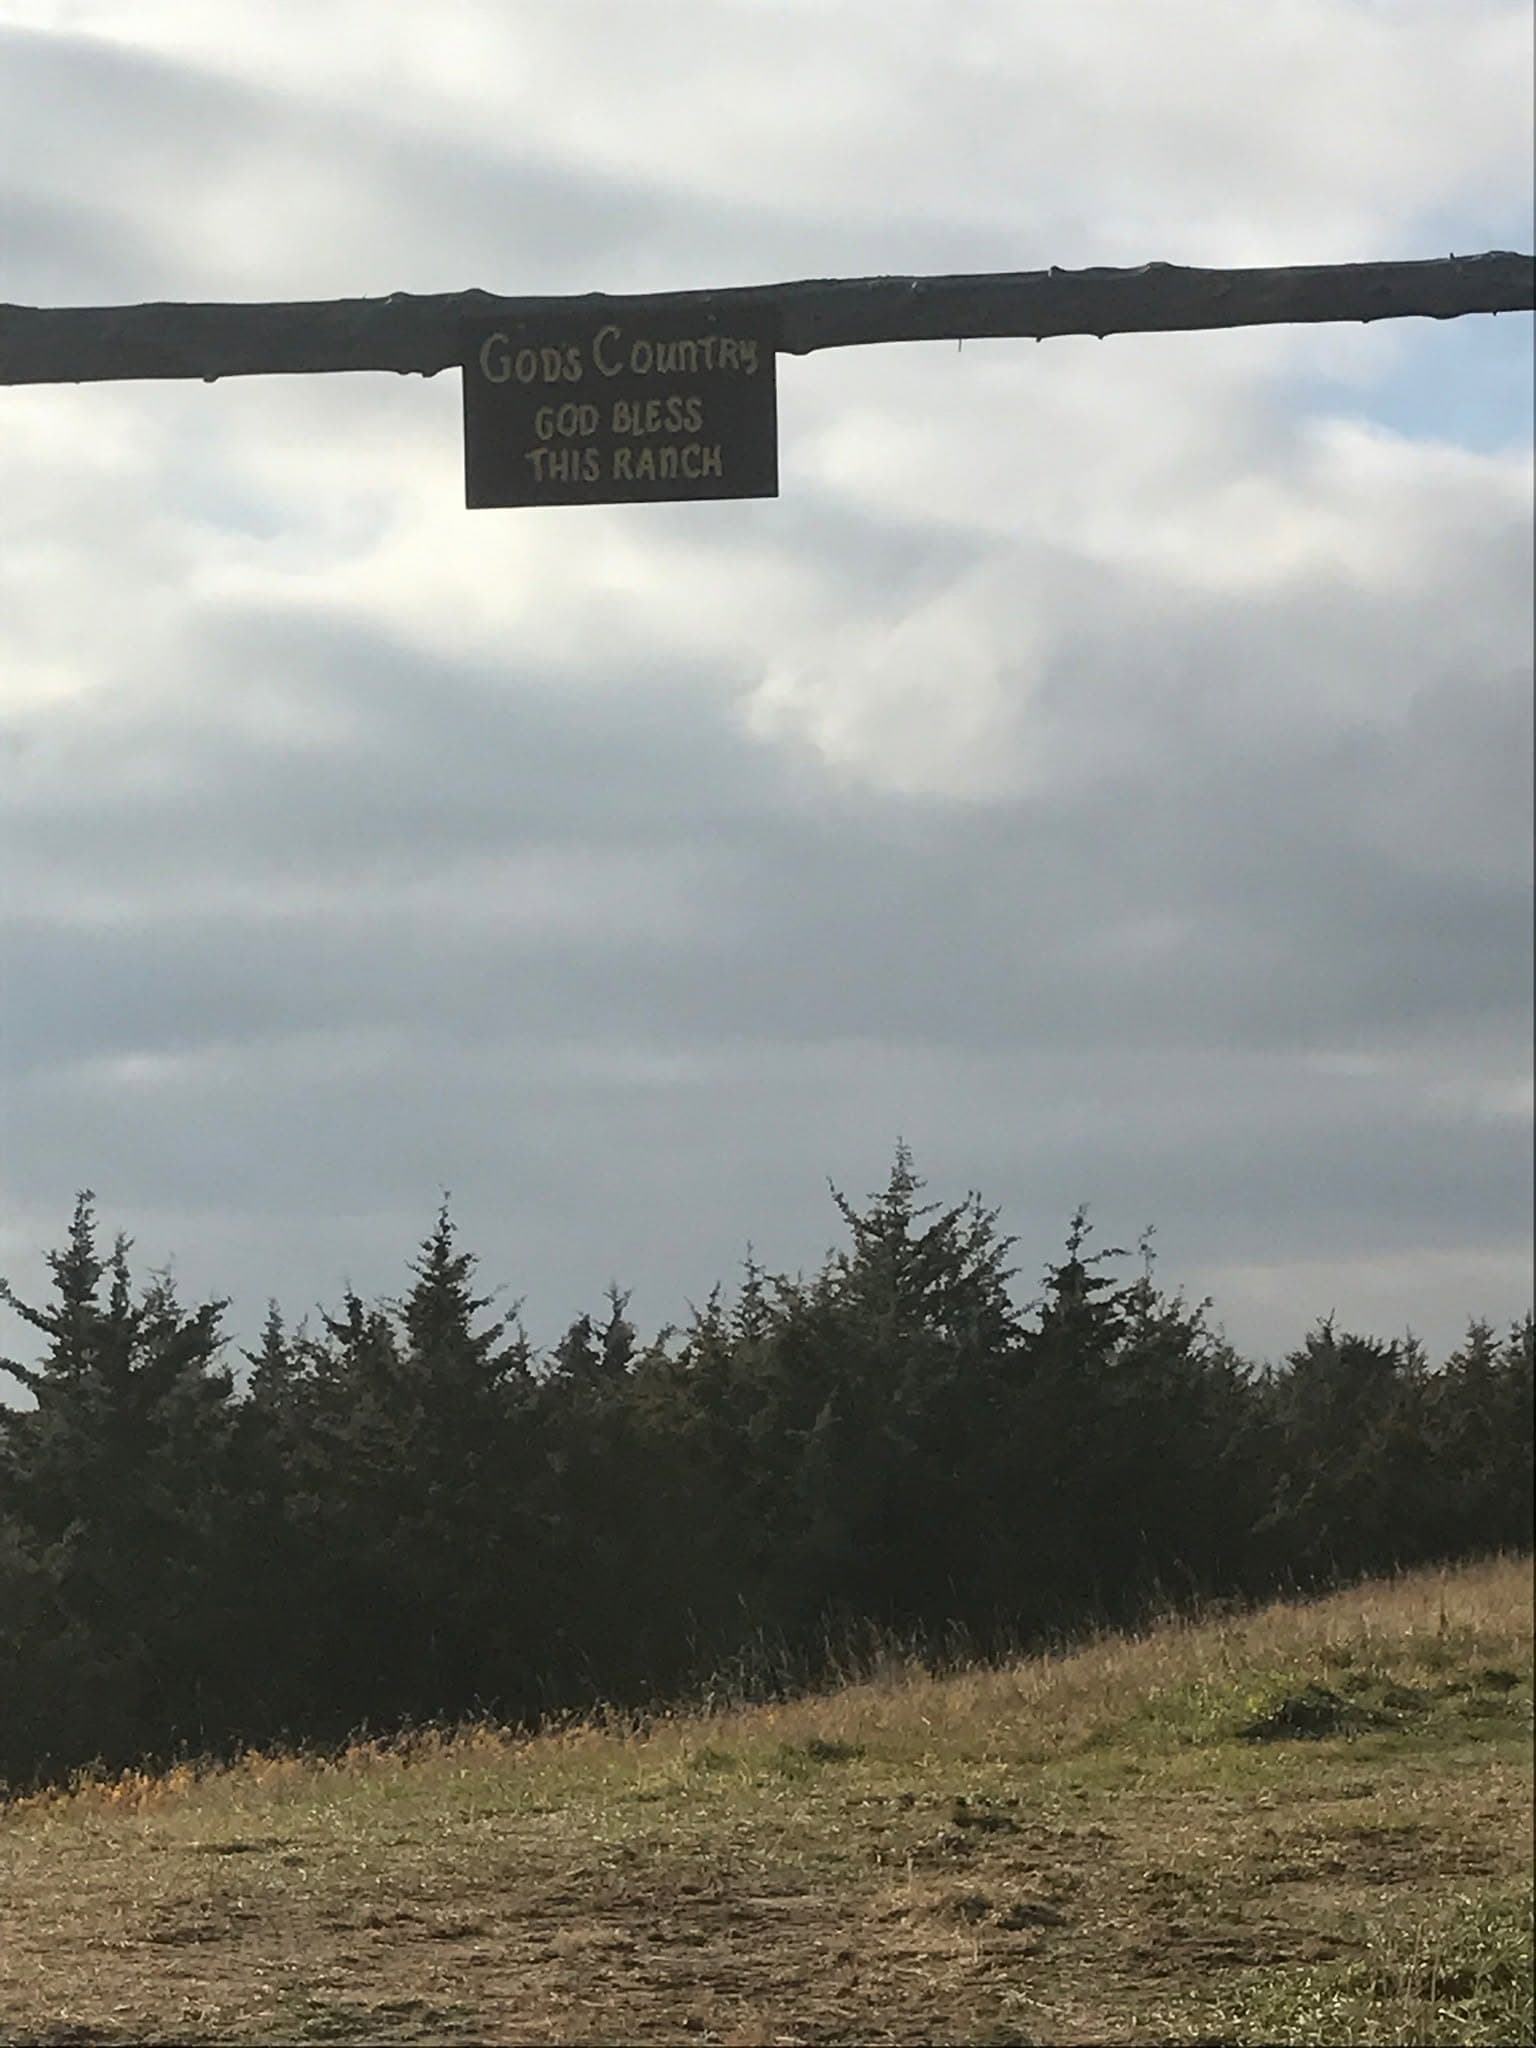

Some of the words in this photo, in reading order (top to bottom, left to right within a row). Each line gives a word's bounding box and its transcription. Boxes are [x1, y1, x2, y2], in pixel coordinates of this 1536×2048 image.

[535, 403, 600, 440] GOD
[611, 397, 703, 436] BLESS
[525, 448, 600, 482] THIS
[612, 445, 723, 480] RANCH
